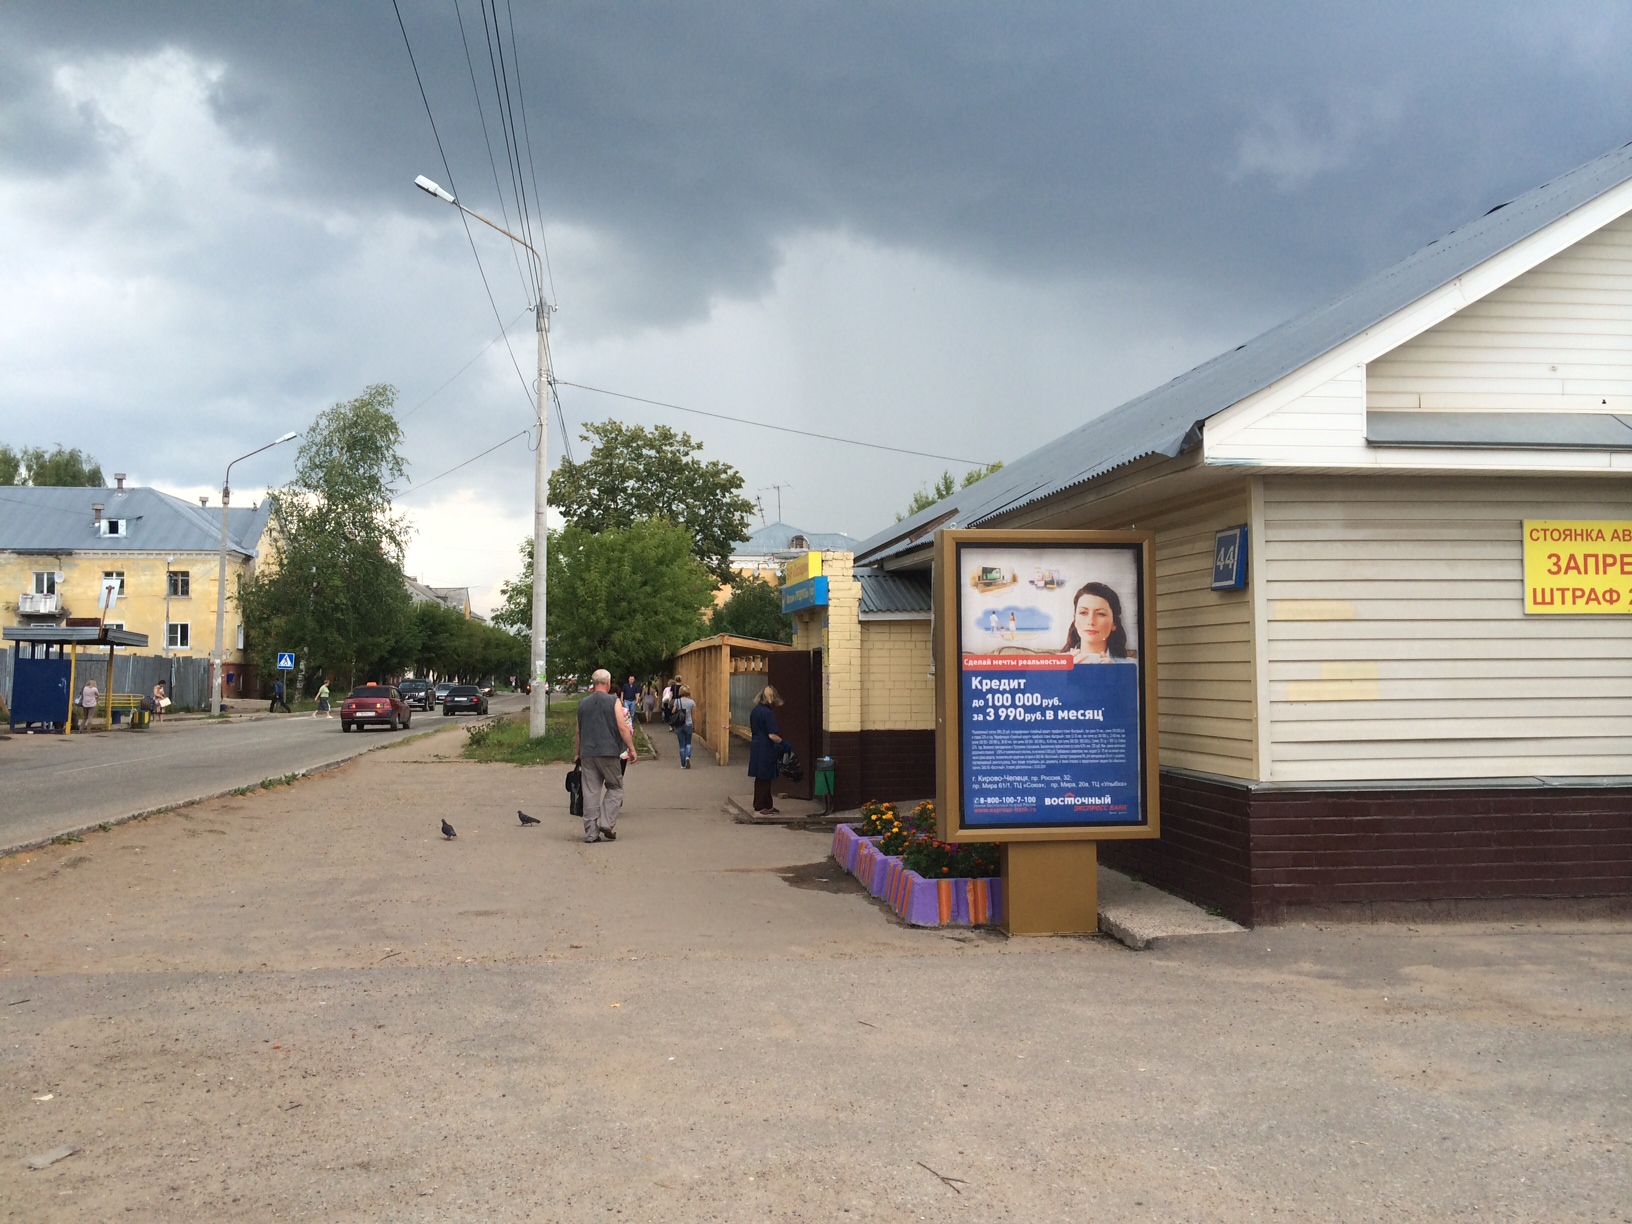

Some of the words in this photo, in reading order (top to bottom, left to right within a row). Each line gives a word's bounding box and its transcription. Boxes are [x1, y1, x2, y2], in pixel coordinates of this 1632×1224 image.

[1529, 528, 1606, 542] СТОЯНКА
[1216, 545, 1234, 571] 44
[1547, 553, 1632, 575] ЗАПРЕ
[1532, 587, 1621, 606] ШТРАФ
[963, 658, 991, 667] Сделай
[1018, 658, 1067, 667] реальностью
[971, 676, 1026, 692] Кредит
[972, 698, 984, 707] до
[986, 693, 1012, 706] 100
[1015, 693, 1041, 706] 000
[1042, 697, 1062, 707] руб.
[972, 713, 984, 721] за
[986, 708, 995, 721] 3
[998, 708, 1025, 721] 990
[1025, 712, 1045, 722] руб.
[1046, 710, 1054, 720] в
